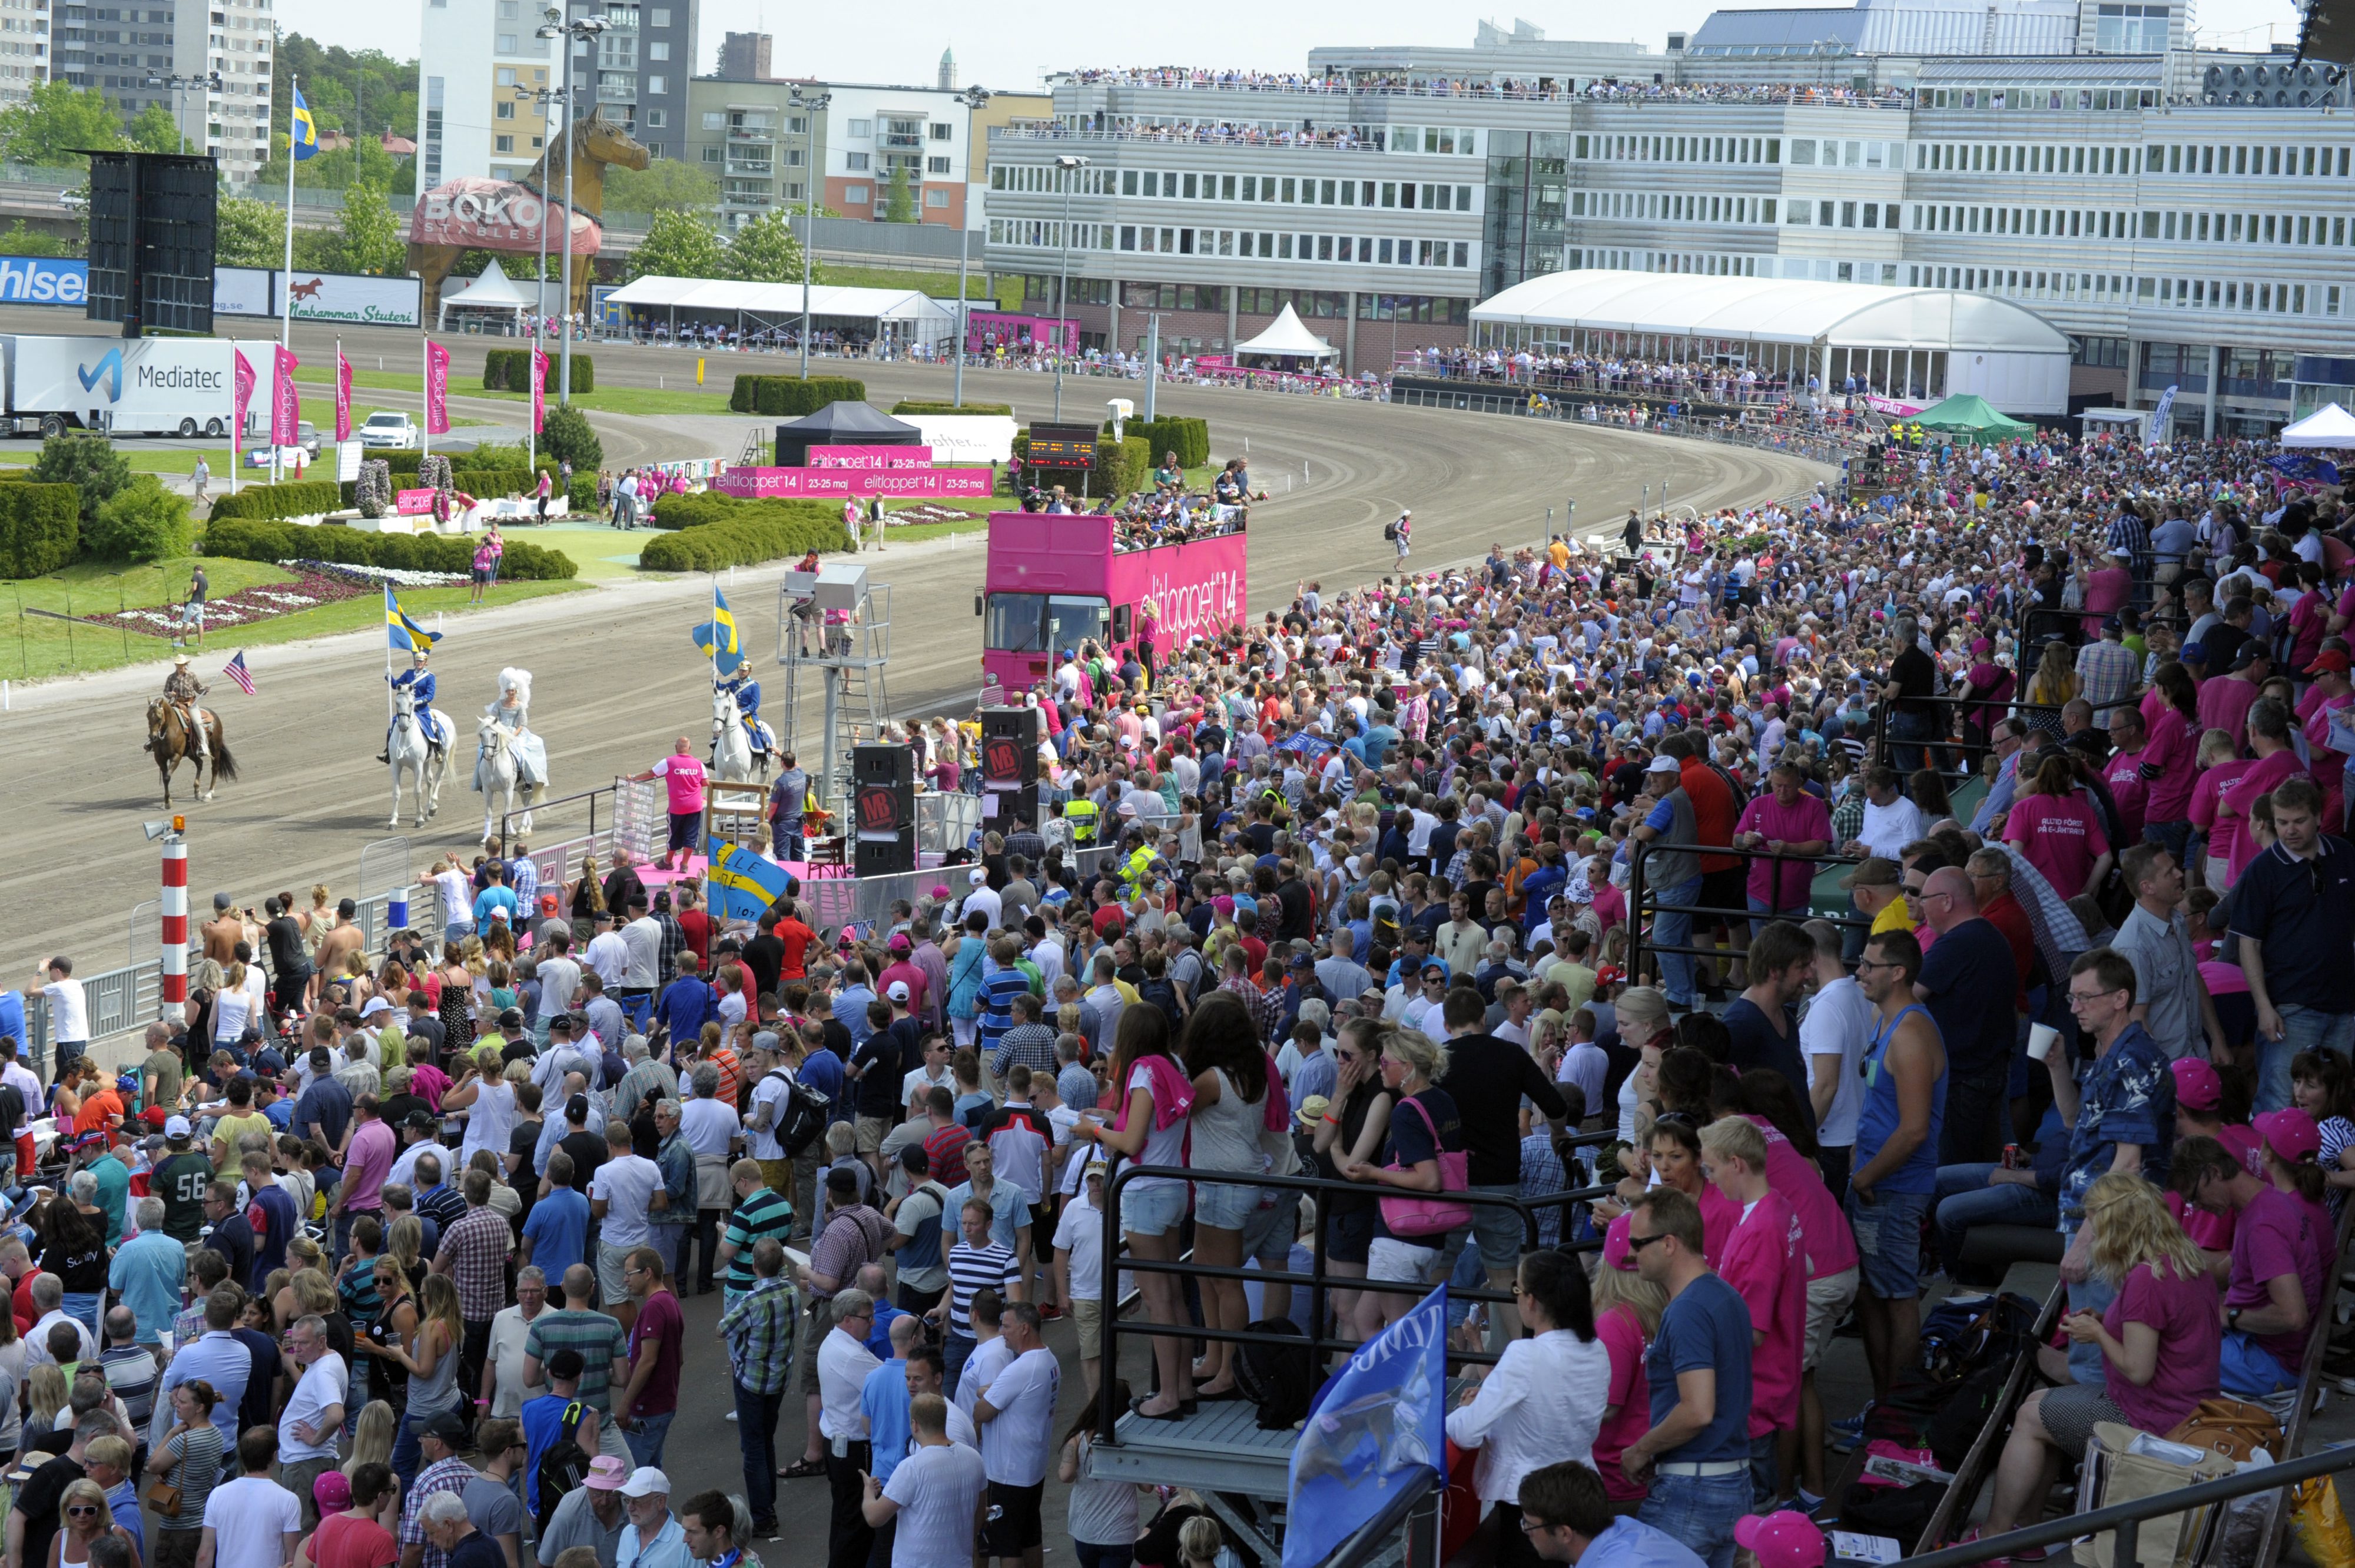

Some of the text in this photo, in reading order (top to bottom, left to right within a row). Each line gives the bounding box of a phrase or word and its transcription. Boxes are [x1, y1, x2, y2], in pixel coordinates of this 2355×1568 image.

[424, 194, 543, 227] BOKO
[424, 224, 536, 239] STABLES
[362, 305, 412, 323] Stuteri
[139, 366, 222, 388] Mediatec
[893, 459, 915, 468] 23-25
[808, 479, 831, 488] 23-25
[832, 479, 848, 490] maj
[946, 479, 968, 488] 23-25
[970, 480, 984, 490] maj
[988, 745, 1016, 772] MB
[861, 793, 891, 821] MB
[2038, 825, 2046, 833] PÅ
[2063, 818, 2083, 827] FÖRST
[177, 1172, 206, 1202] 56
